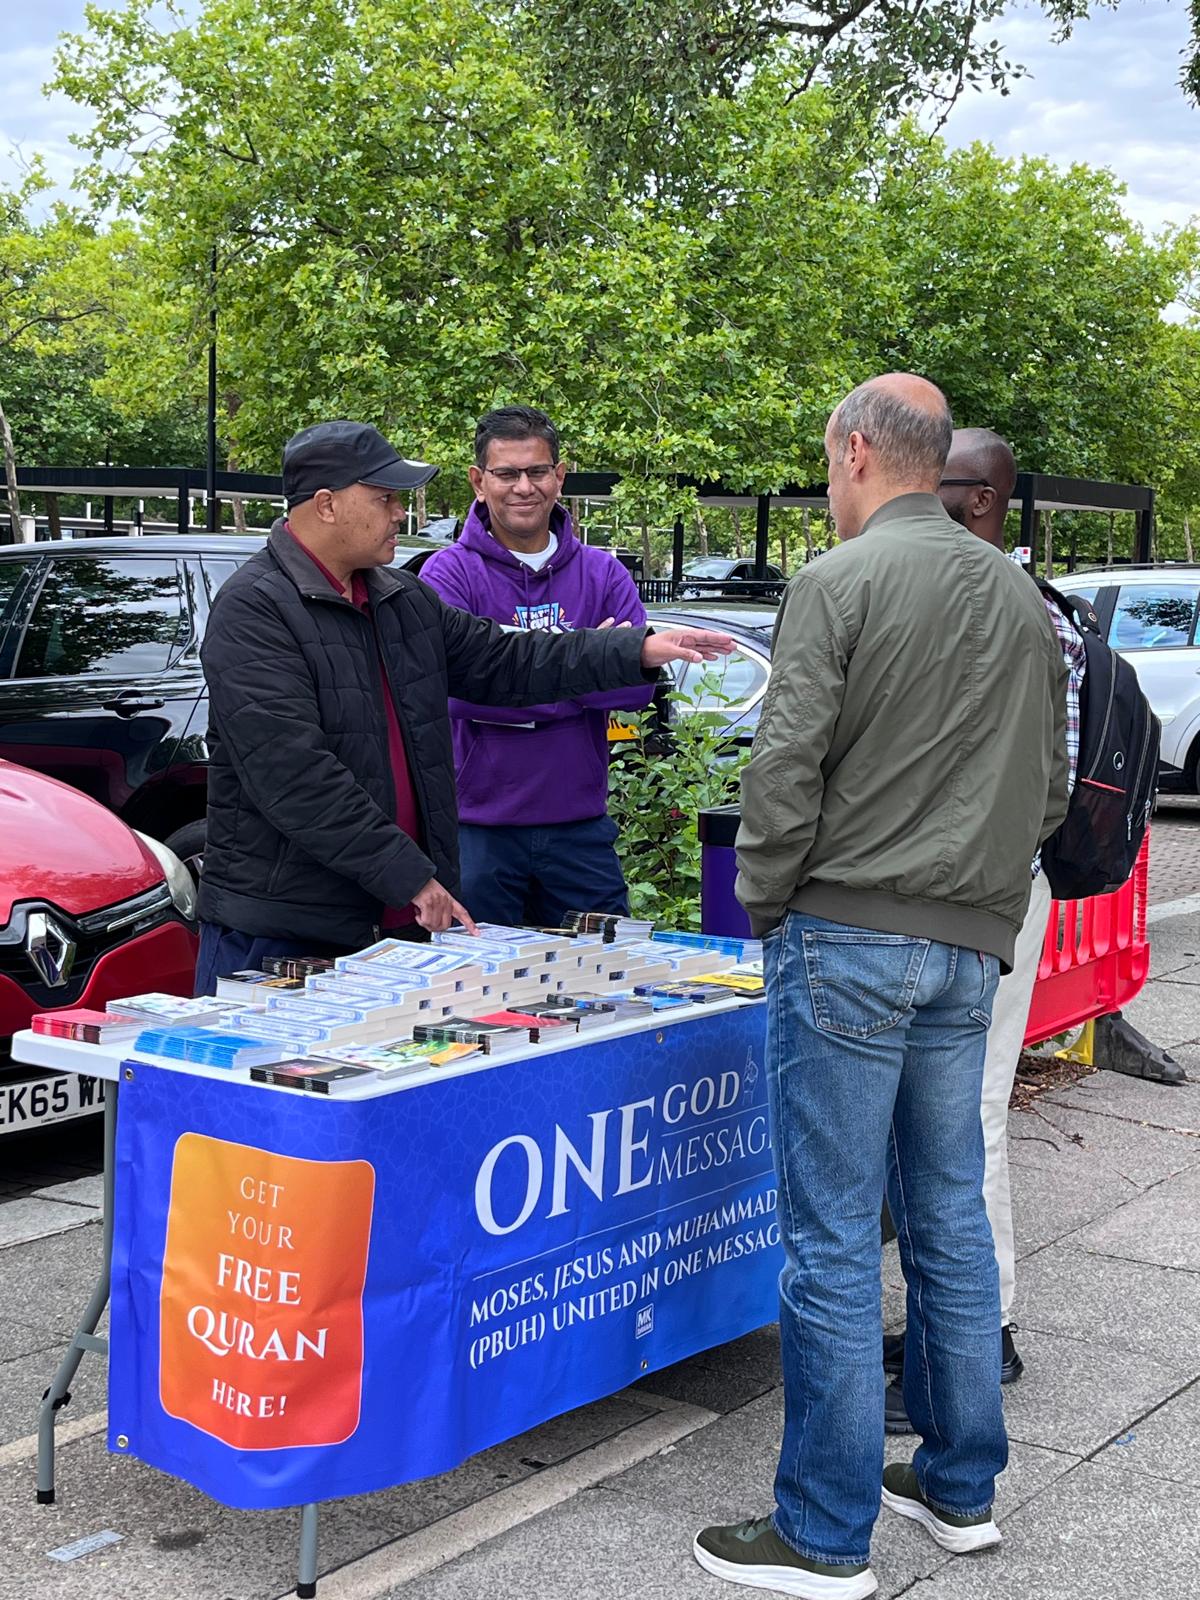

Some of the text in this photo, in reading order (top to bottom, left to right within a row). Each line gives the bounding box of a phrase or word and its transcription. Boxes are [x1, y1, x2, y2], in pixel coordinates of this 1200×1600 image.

[662, 1070, 740, 1124] GOD
[474, 1096, 656, 1236] ONE
[656, 1115, 773, 1185] MESSAG
[240, 1176, 284, 1208] GET
[227, 1210, 295, 1250] YOUR
[217, 1252, 301, 1306] FREE
[469, 1188, 779, 1328] MOSES, JESUS AND MUHAMMAD
[469, 1222, 780, 1370] (PBUH) UNITED IN ONE MESSAG
[187, 1305, 329, 1362] QURAN
[211, 1378, 287, 1419] HERE!
